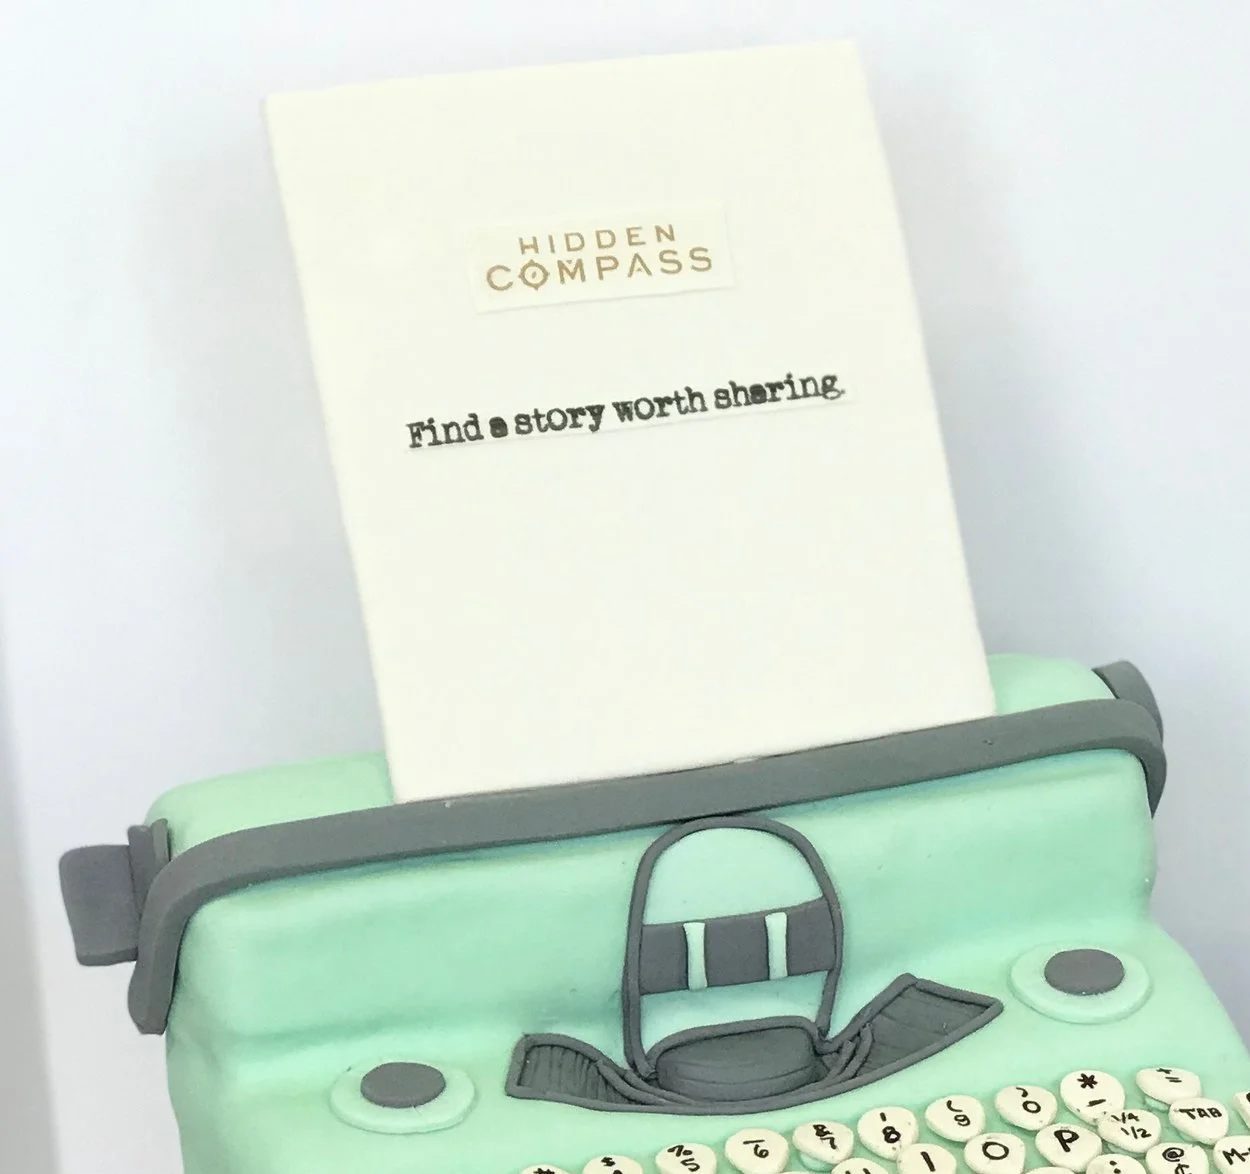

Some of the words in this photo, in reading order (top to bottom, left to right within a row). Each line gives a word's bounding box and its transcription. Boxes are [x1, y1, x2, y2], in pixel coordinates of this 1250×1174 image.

[518, 223, 677, 255] HIDDEN
[486, 246, 713, 292] COMPASS
[406, 413, 485, 449] Find
[489, 415, 508, 439] a
[513, 404, 606, 434] story
[612, 387, 708, 423] worth
[681, 1157, 701, 1173] 5
[754, 1143, 770, 1159] 6
[882, 1125, 901, 1144] 8
[1054, 1129, 1080, 1153] P
[1178, 1107, 1223, 1120] TAB
